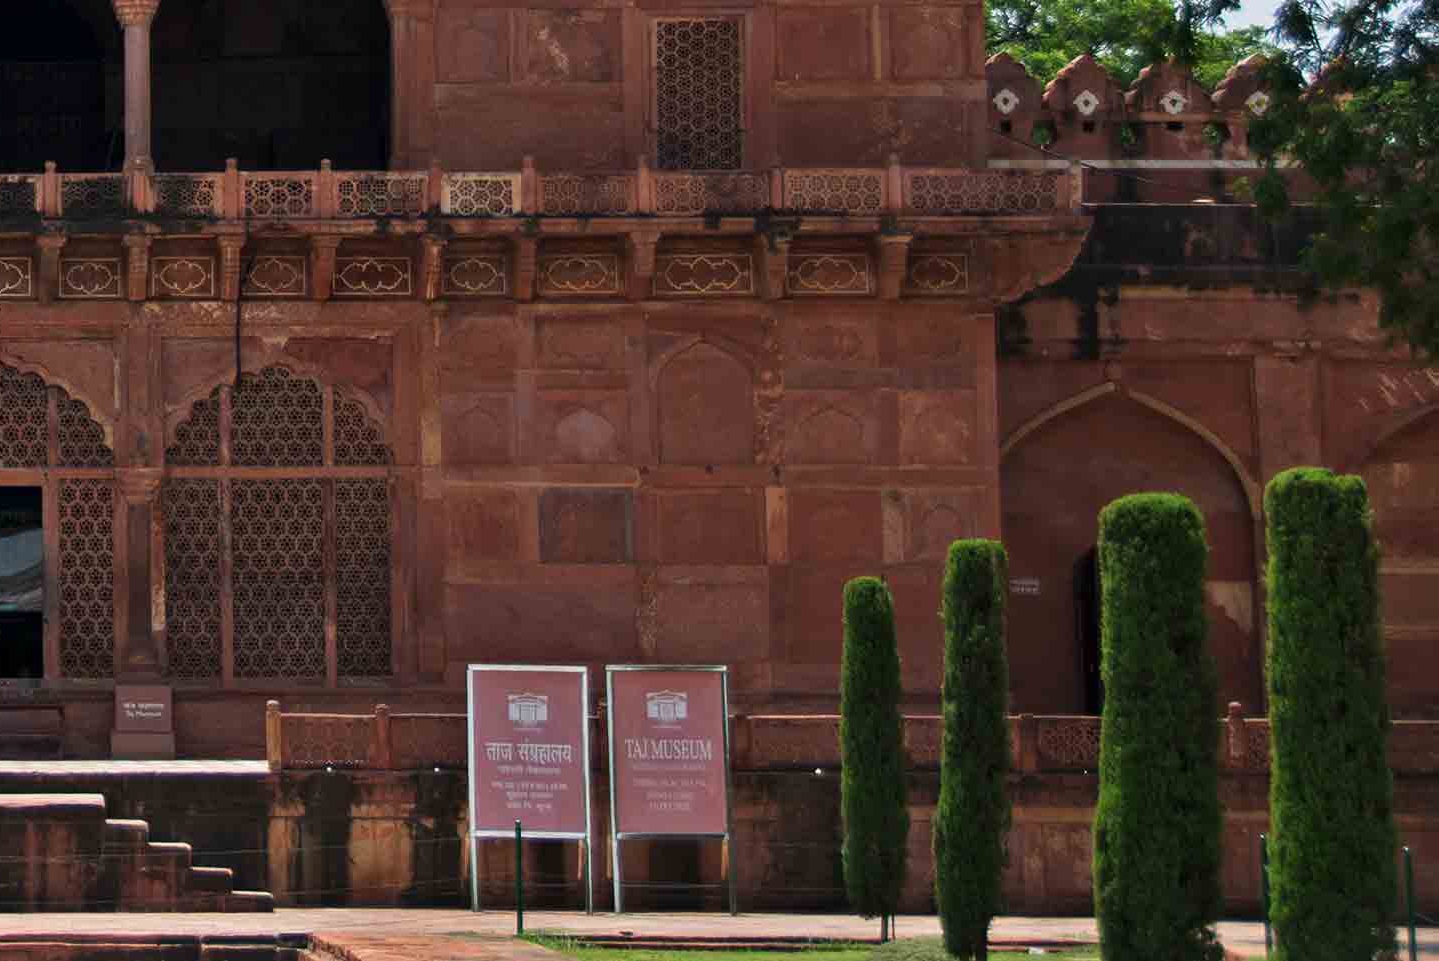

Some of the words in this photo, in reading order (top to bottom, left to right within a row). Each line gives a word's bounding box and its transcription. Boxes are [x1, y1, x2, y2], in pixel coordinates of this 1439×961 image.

[485, 742, 513, 761] ताज
[517, 737, 572, 765] संग्रहालय
[624, 739, 649, 760] TAJ
[651, 739, 712, 760] MUSEUM
